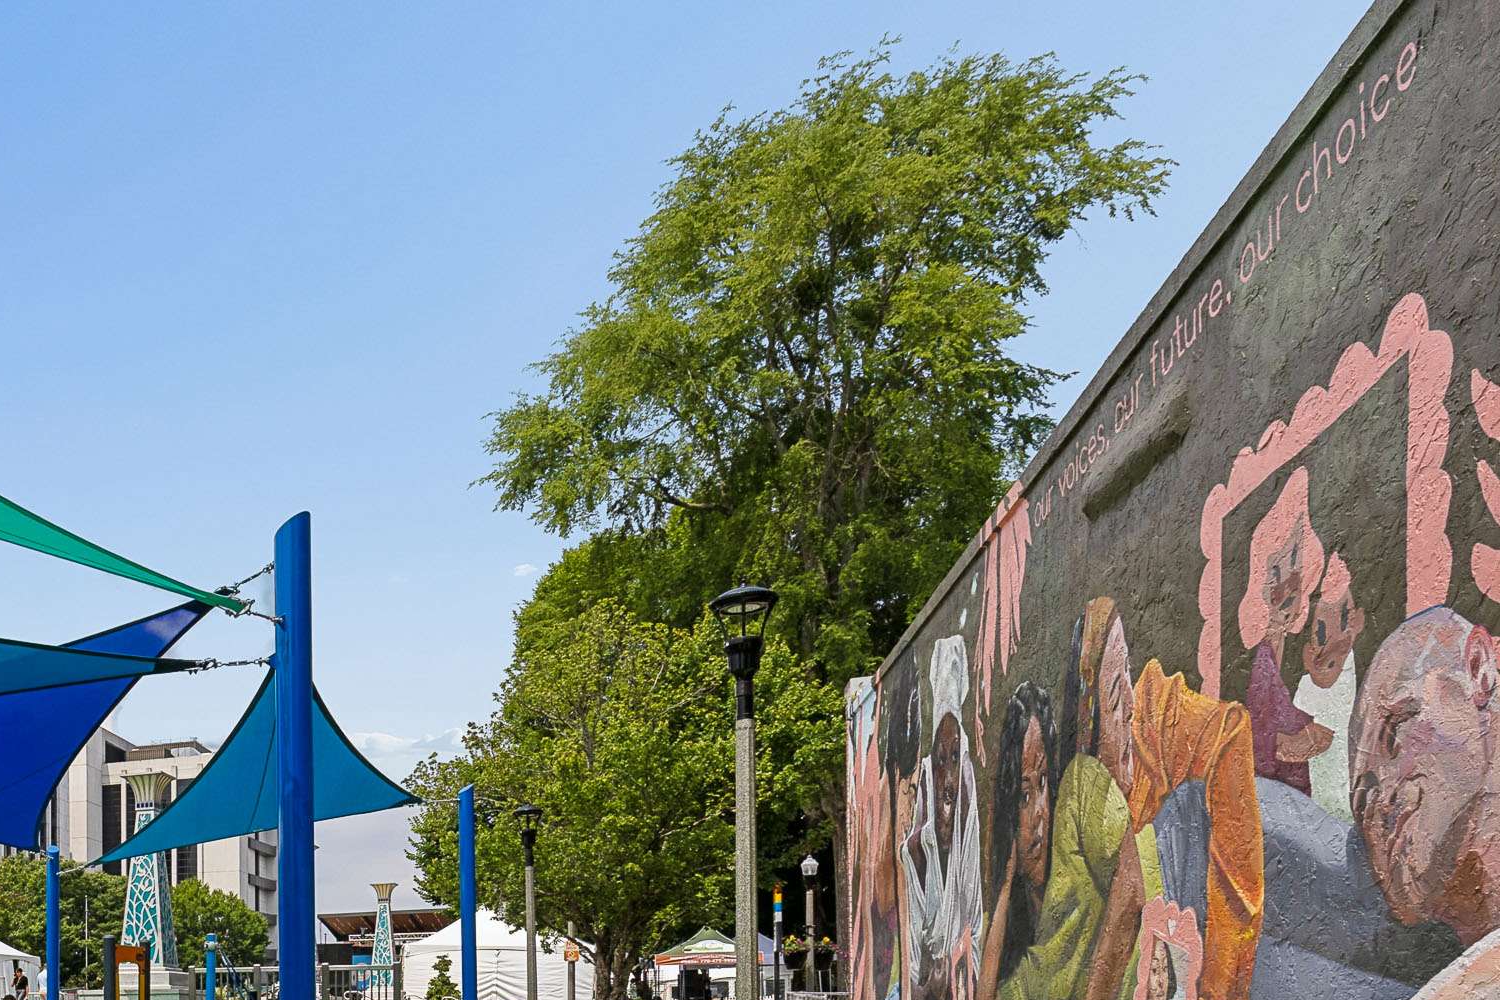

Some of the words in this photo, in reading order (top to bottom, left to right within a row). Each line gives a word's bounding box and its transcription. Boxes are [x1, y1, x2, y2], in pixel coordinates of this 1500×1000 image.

[1034, 485, 1054, 527] our
[1058, 424, 1110, 497] voices,
[1114, 373, 1144, 433] our
[1149, 278, 1232, 387] future,
[1239, 193, 1289, 284] our
[1295, 42, 1418, 214] choice
